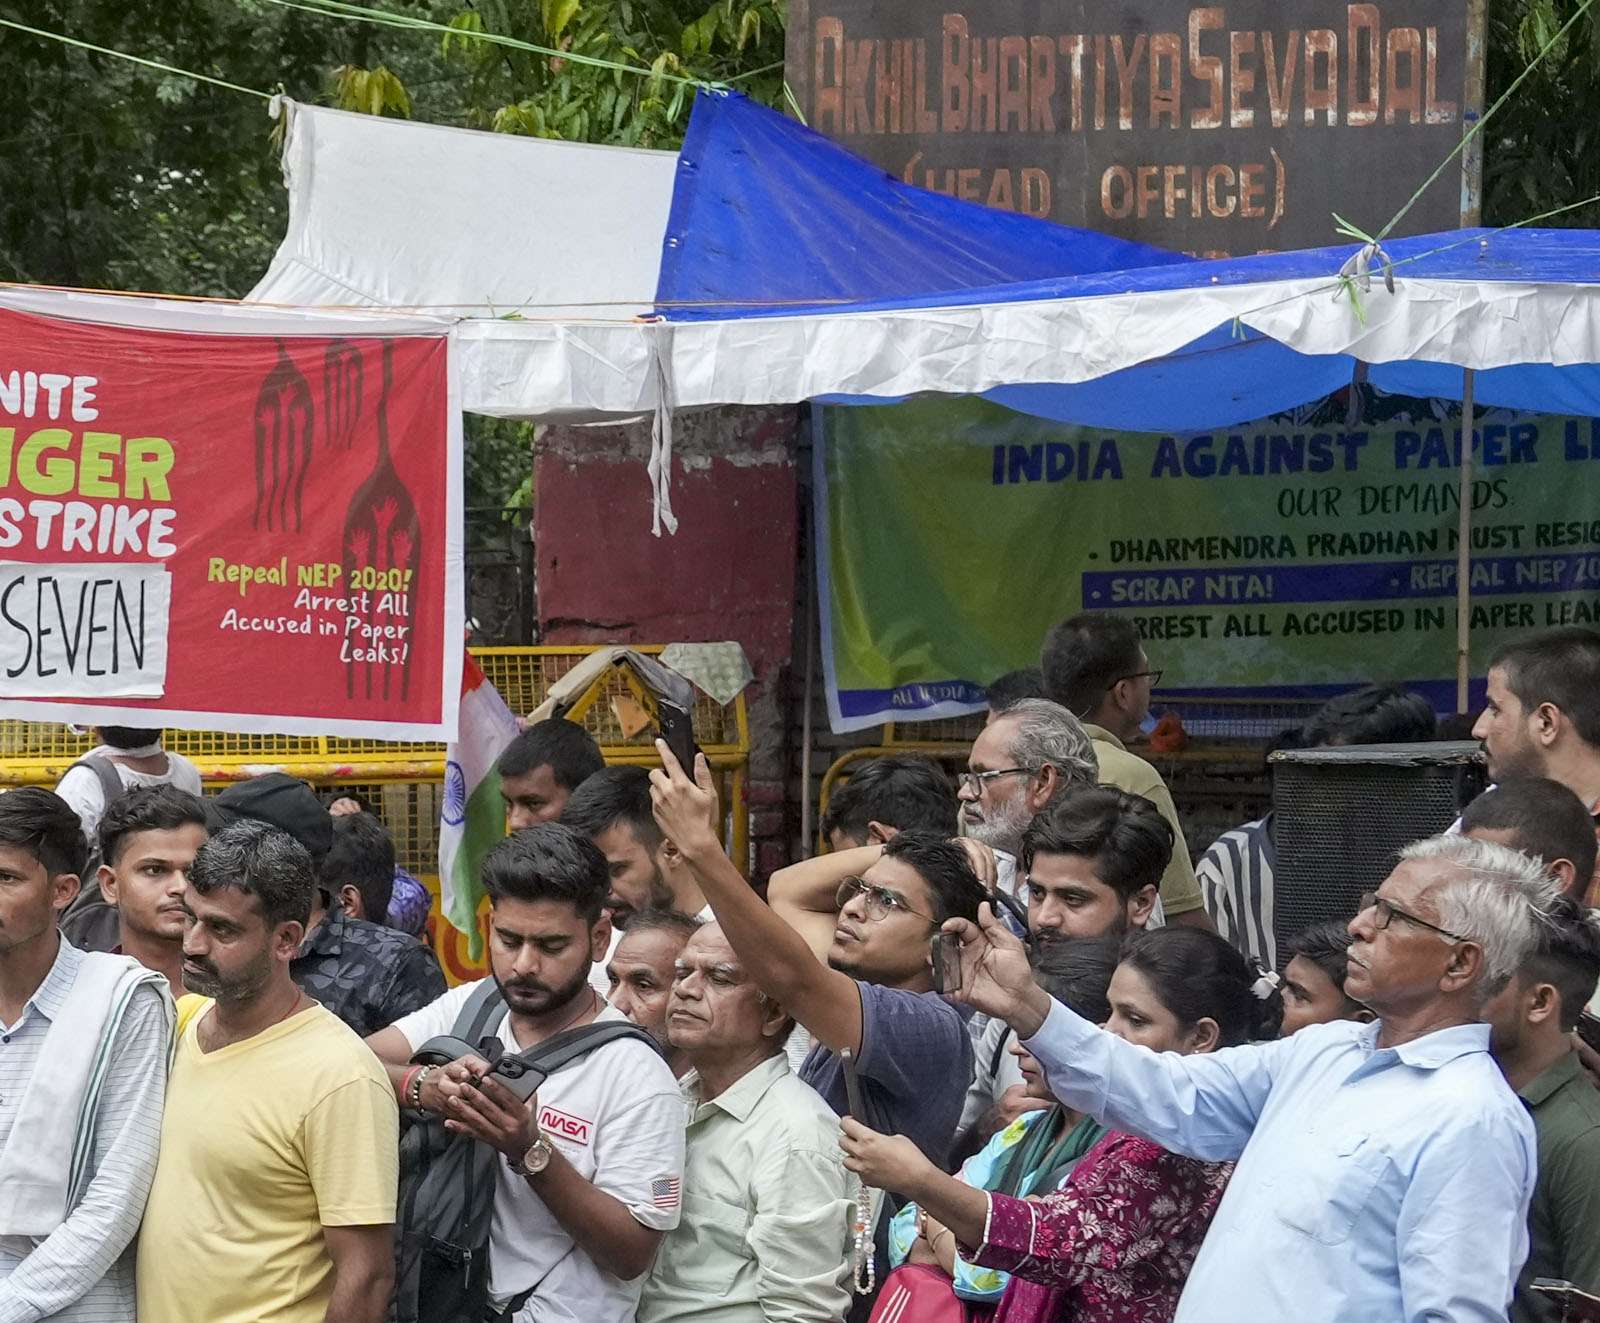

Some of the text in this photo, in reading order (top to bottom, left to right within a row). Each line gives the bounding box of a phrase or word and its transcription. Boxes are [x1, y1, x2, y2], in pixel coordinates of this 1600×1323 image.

[813, 3, 1457, 134] AKHIL BHARTIYA SEVA DAL
[1100, 146, 1285, 230] OFFICE)
[992, 439, 1124, 485] INDIA
[1150, 431, 1369, 478] AGAINST
[1394, 422, 1539, 470] PAPER
[1277, 486, 1342, 518] OUR
[1110, 534, 1296, 563] DHARMENDRA
[1307, 530, 1439, 557] PRADHAN
[207, 556, 413, 597] Repeal NEP 2020!
[1111, 572, 1274, 603] SCRAP NTA!
[1410, 561, 1505, 590] REPAL
[1515, 558, 1567, 586] NEP
[293, 588, 409, 617] Arrest All
[0, 574, 145, 678] SEVEN
[220, 608, 409, 647] Accused in Paper
[1224, 612, 1273, 639] ALL
[1283, 606, 1405, 638] ACCUSED
[1415, 605, 1445, 631] IN
[339, 639, 409, 665] Leaks!
[542, 1111, 586, 1140] NASA
